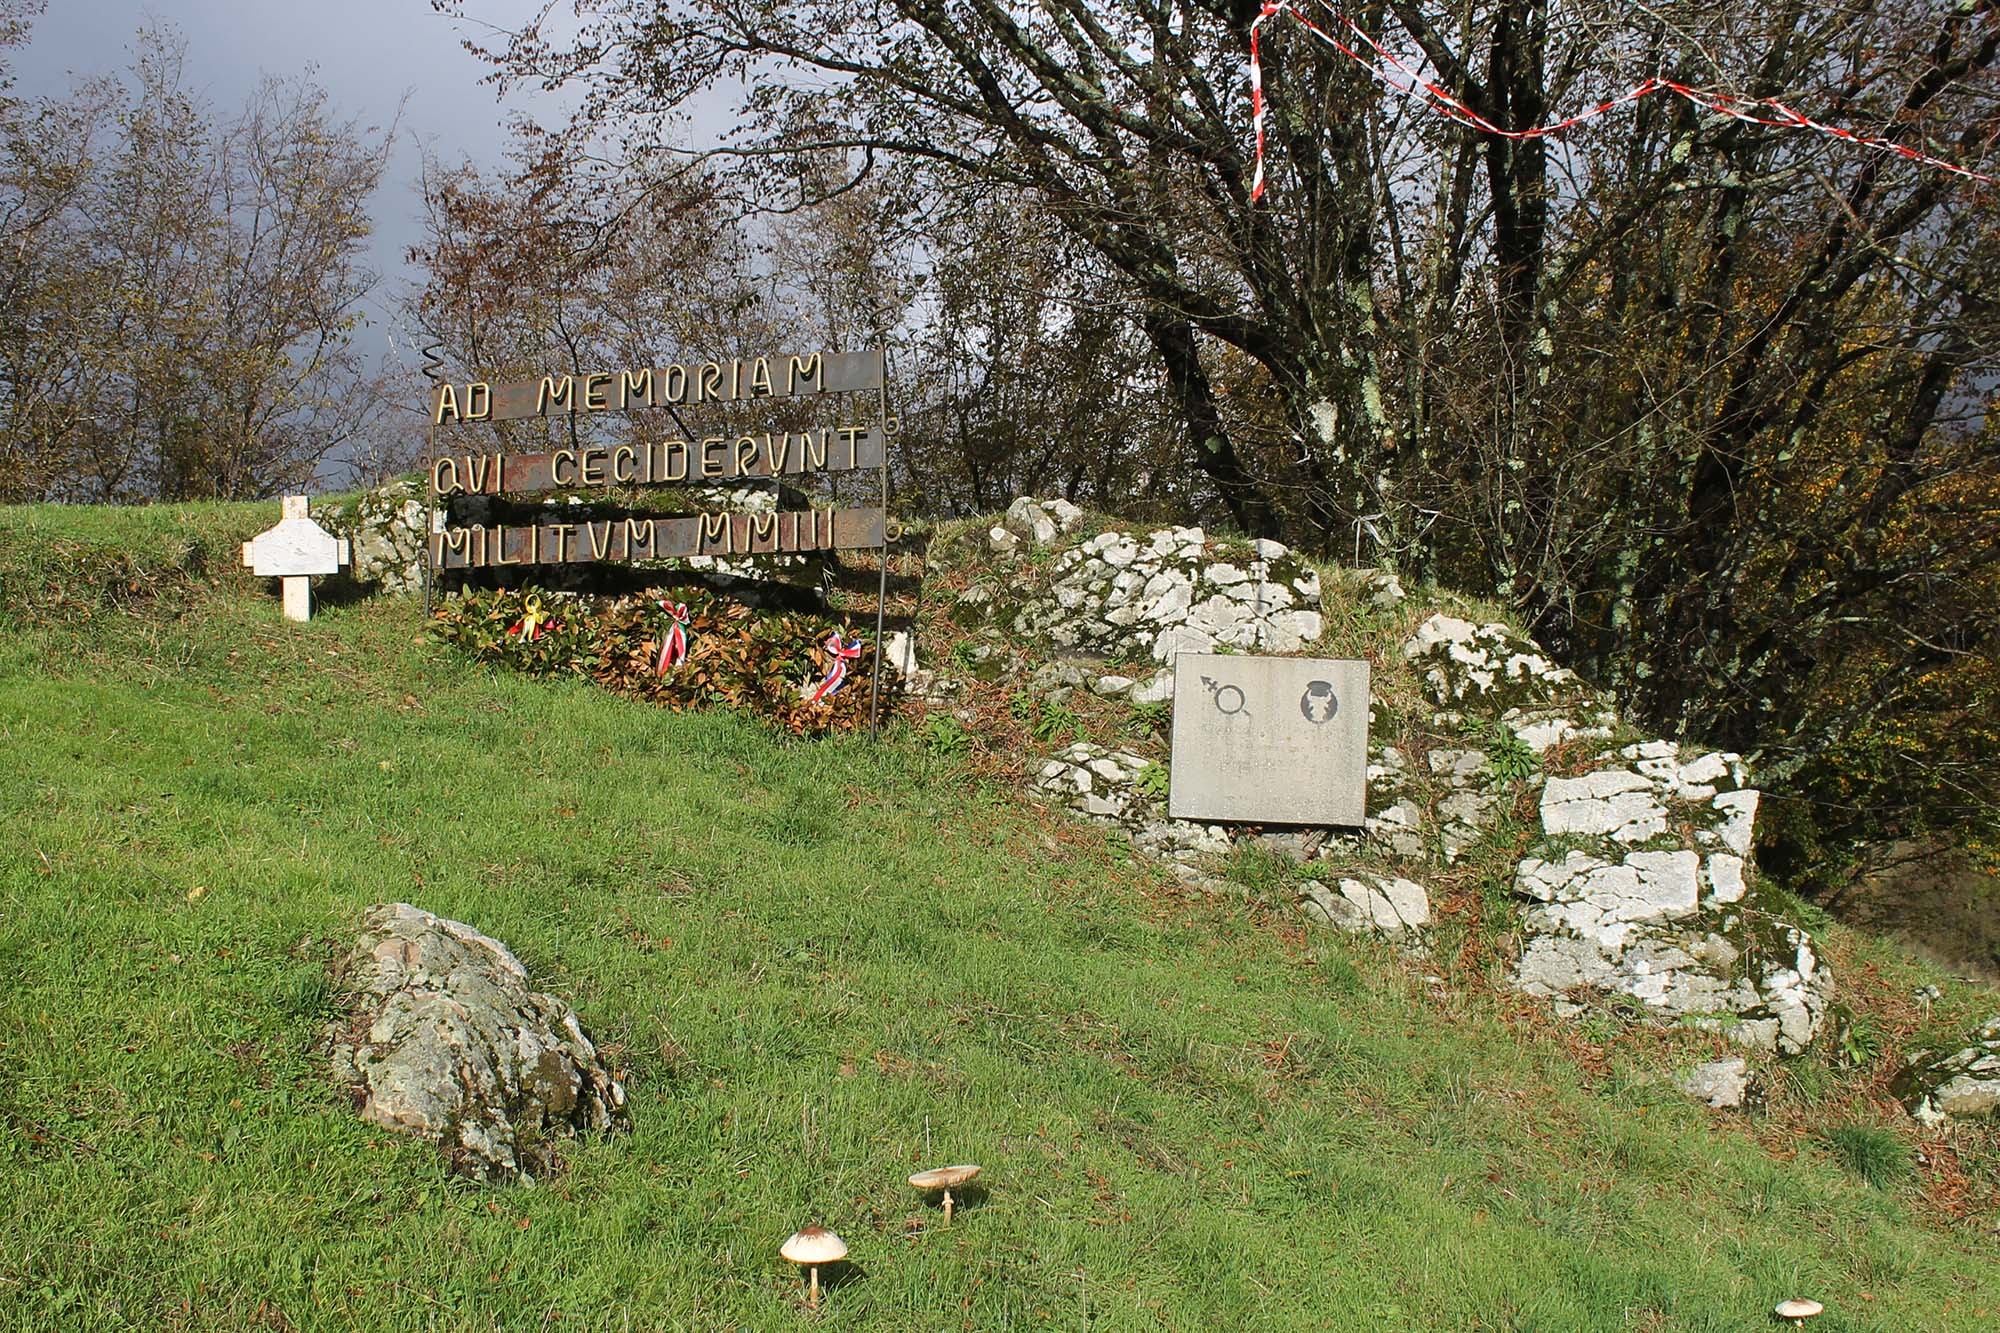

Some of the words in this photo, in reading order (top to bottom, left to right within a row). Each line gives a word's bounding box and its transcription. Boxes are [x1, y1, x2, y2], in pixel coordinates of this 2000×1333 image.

[437, 384, 490, 424] AD
[536, 352, 822, 412] MEMORIAM
[434, 453, 502, 494] QVI
[552, 428, 865, 486] CECIDERVNT
[437, 518, 656, 567] MILITVM
[696, 507, 832, 553] MMIII
